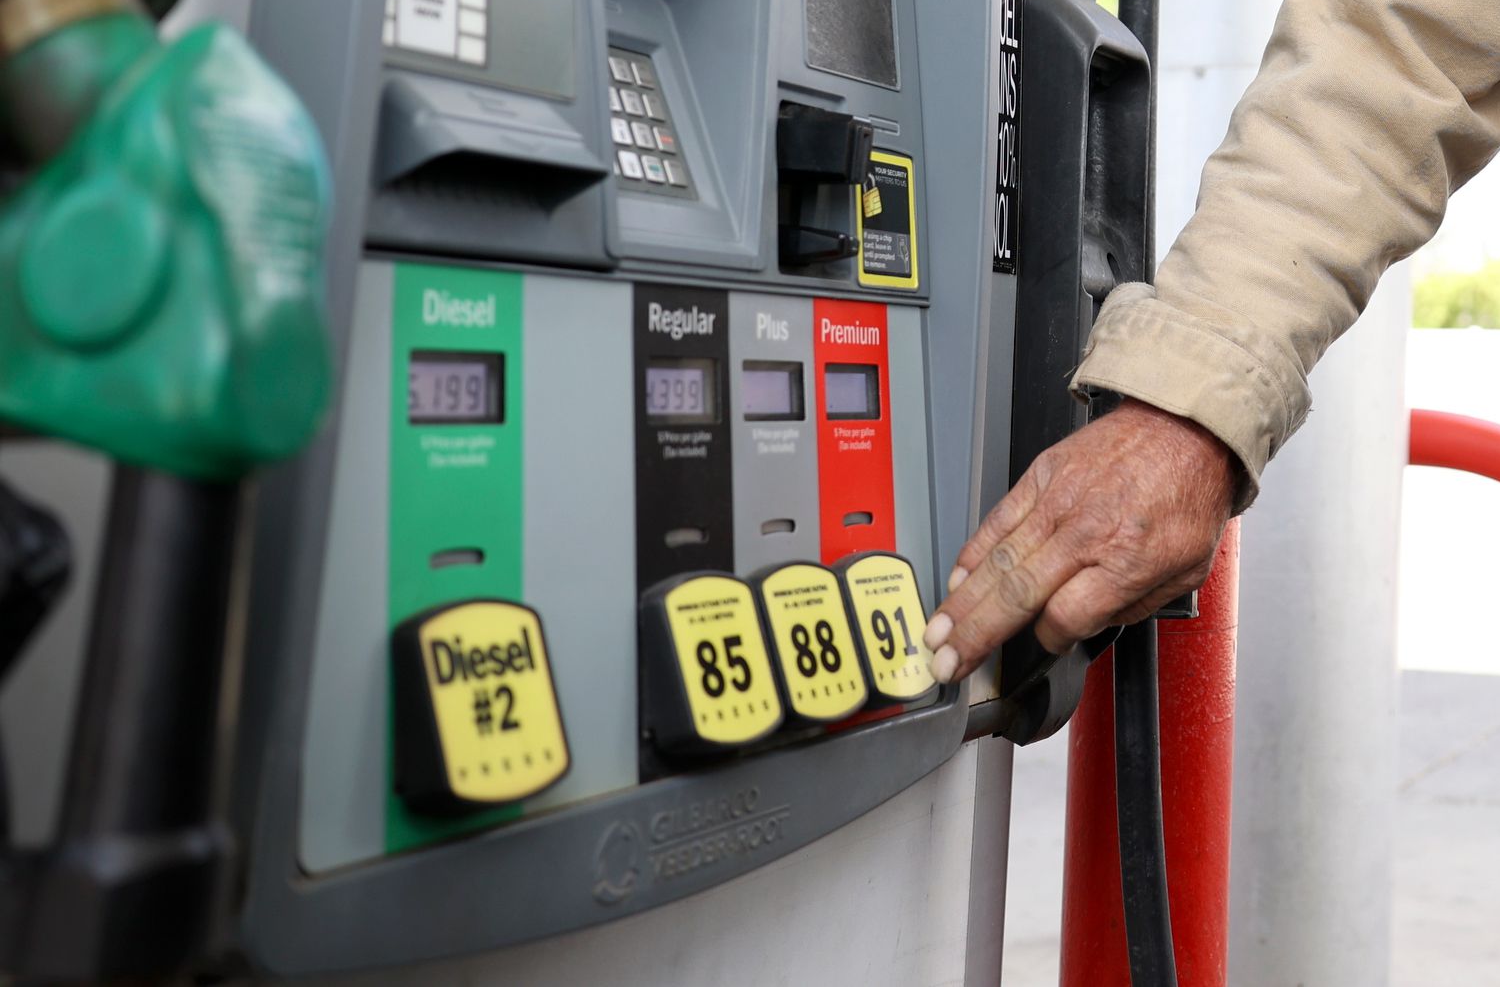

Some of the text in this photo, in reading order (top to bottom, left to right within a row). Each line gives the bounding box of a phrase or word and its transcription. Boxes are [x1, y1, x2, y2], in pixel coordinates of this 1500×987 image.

[1000, 50, 1017, 119] INS
[875, 166, 907, 179] YOUR SECURITY
[999, 121, 1017, 189] 10%
[421, 288, 497, 328] Diesel
[648, 302, 716, 341] Regular
[756, 313, 789, 341] Plus
[821, 318, 880, 346] Premium
[430, 625, 536, 687] Diesel
[791, 619, 842, 678] 88
[871, 605, 919, 661] 91
[696, 634, 752, 699] 85
[473, 684, 521, 737] #2
[651, 786, 761, 844] GILBARCO
